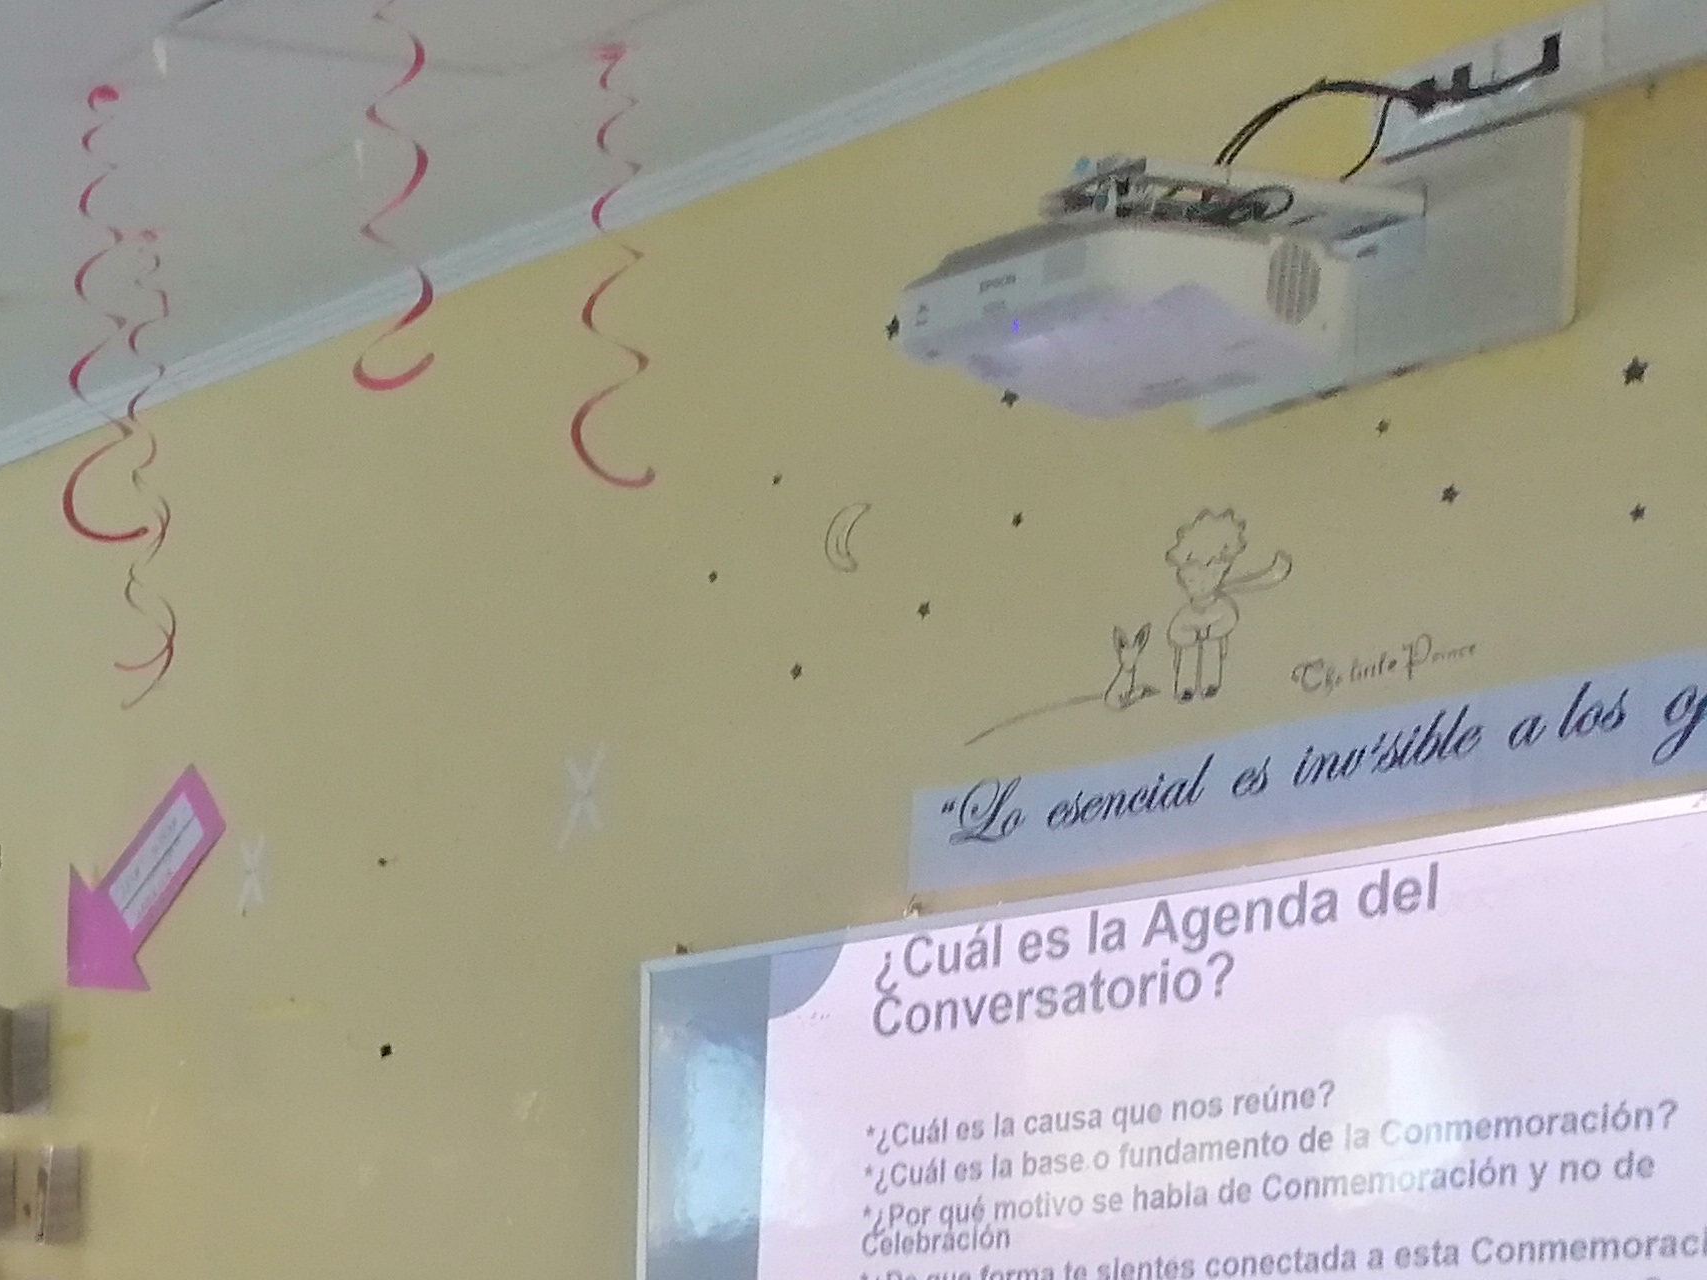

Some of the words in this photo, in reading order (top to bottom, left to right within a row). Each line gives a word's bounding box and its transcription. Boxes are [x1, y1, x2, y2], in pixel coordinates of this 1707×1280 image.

[1046, 752, 1215, 831] esencial
[1231, 754, 1272, 798] es
[1507, 713, 1547, 751] a
[1557, 680, 1630, 743] los
[873, 921, 1003, 996] ¿Cuál
[1018, 925, 1071, 964] es
[1088, 910, 1127, 955] la
[1141, 880, 1339, 954] Agenda
[1358, 861, 1439, 920] del
[873, 950, 1235, 1038] Conversatorio?
[954, 1160, 983, 1182] es
[992, 1153, 1013, 1180] la
[1022, 1150, 1085, 1177] base
[1093, 1150, 1110, 1170] o
[1118, 1130, 1289, 1169] fundamento
[1298, 1126, 1334, 1154] de
[1344, 1123, 1370, 1152] la
[1381, 1097, 1679, 1146] Conmemoración?
[956, 1117, 985, 1141] es
[994, 1112, 1016, 1138] la
[1024, 1108, 1103, 1136] causa
[1112, 1102, 1163, 1133] que
[1172, 1096, 1224, 1122] nos
[1233, 1079, 1336, 1116] reúne?
[939, 1194, 986, 1230] qué
[994, 1192, 1085, 1222] motivo
[1092, 1191, 1123, 1214] se
[1132, 1180, 1208, 1212] habla
[1218, 1177, 1251, 1205] de
[1262, 1156, 1517, 1203] Conmemoración
[1529, 1160, 1548, 1192] y
[1559, 1159, 1602, 1184] no
[1614, 1149, 1655, 1180] de
[861, 1223, 1011, 1257] Celebración
[1205, 1243, 1357, 1279] conectada
[1366, 1248, 1384, 1270] a
[1394, 1239, 1459, 1271] esta
